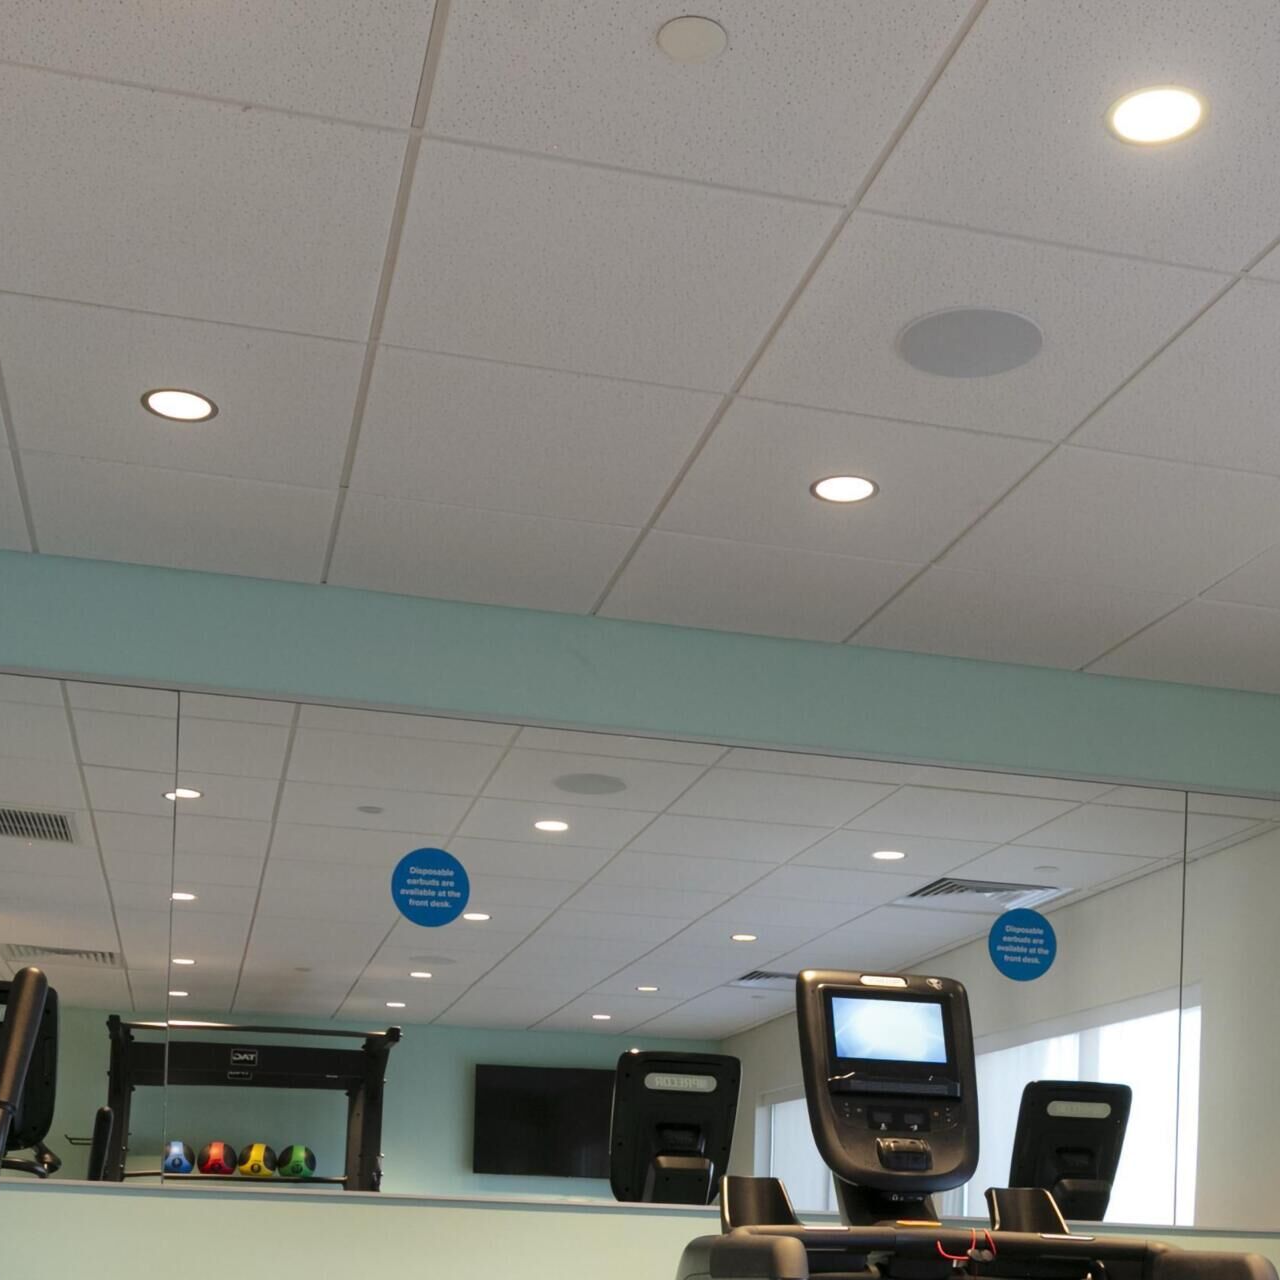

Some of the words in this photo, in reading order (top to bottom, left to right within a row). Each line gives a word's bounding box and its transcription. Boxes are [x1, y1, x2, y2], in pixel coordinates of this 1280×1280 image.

[409, 866, 455, 877] Disposable
[406, 878, 440, 887] earbuds
[441, 880, 455, 888] are
[399, 888, 436, 897] available
[447, 890, 461, 898] the
[408, 898, 429, 907] front
[430, 900, 453, 908] desk.
[1004, 925, 1045, 935] Disposable
[1002, 936, 1031, 944] earbuds
[996, 945, 1027, 953] available
[1037, 947, 1049, 955] the
[1003, 954, 1022, 963] front
